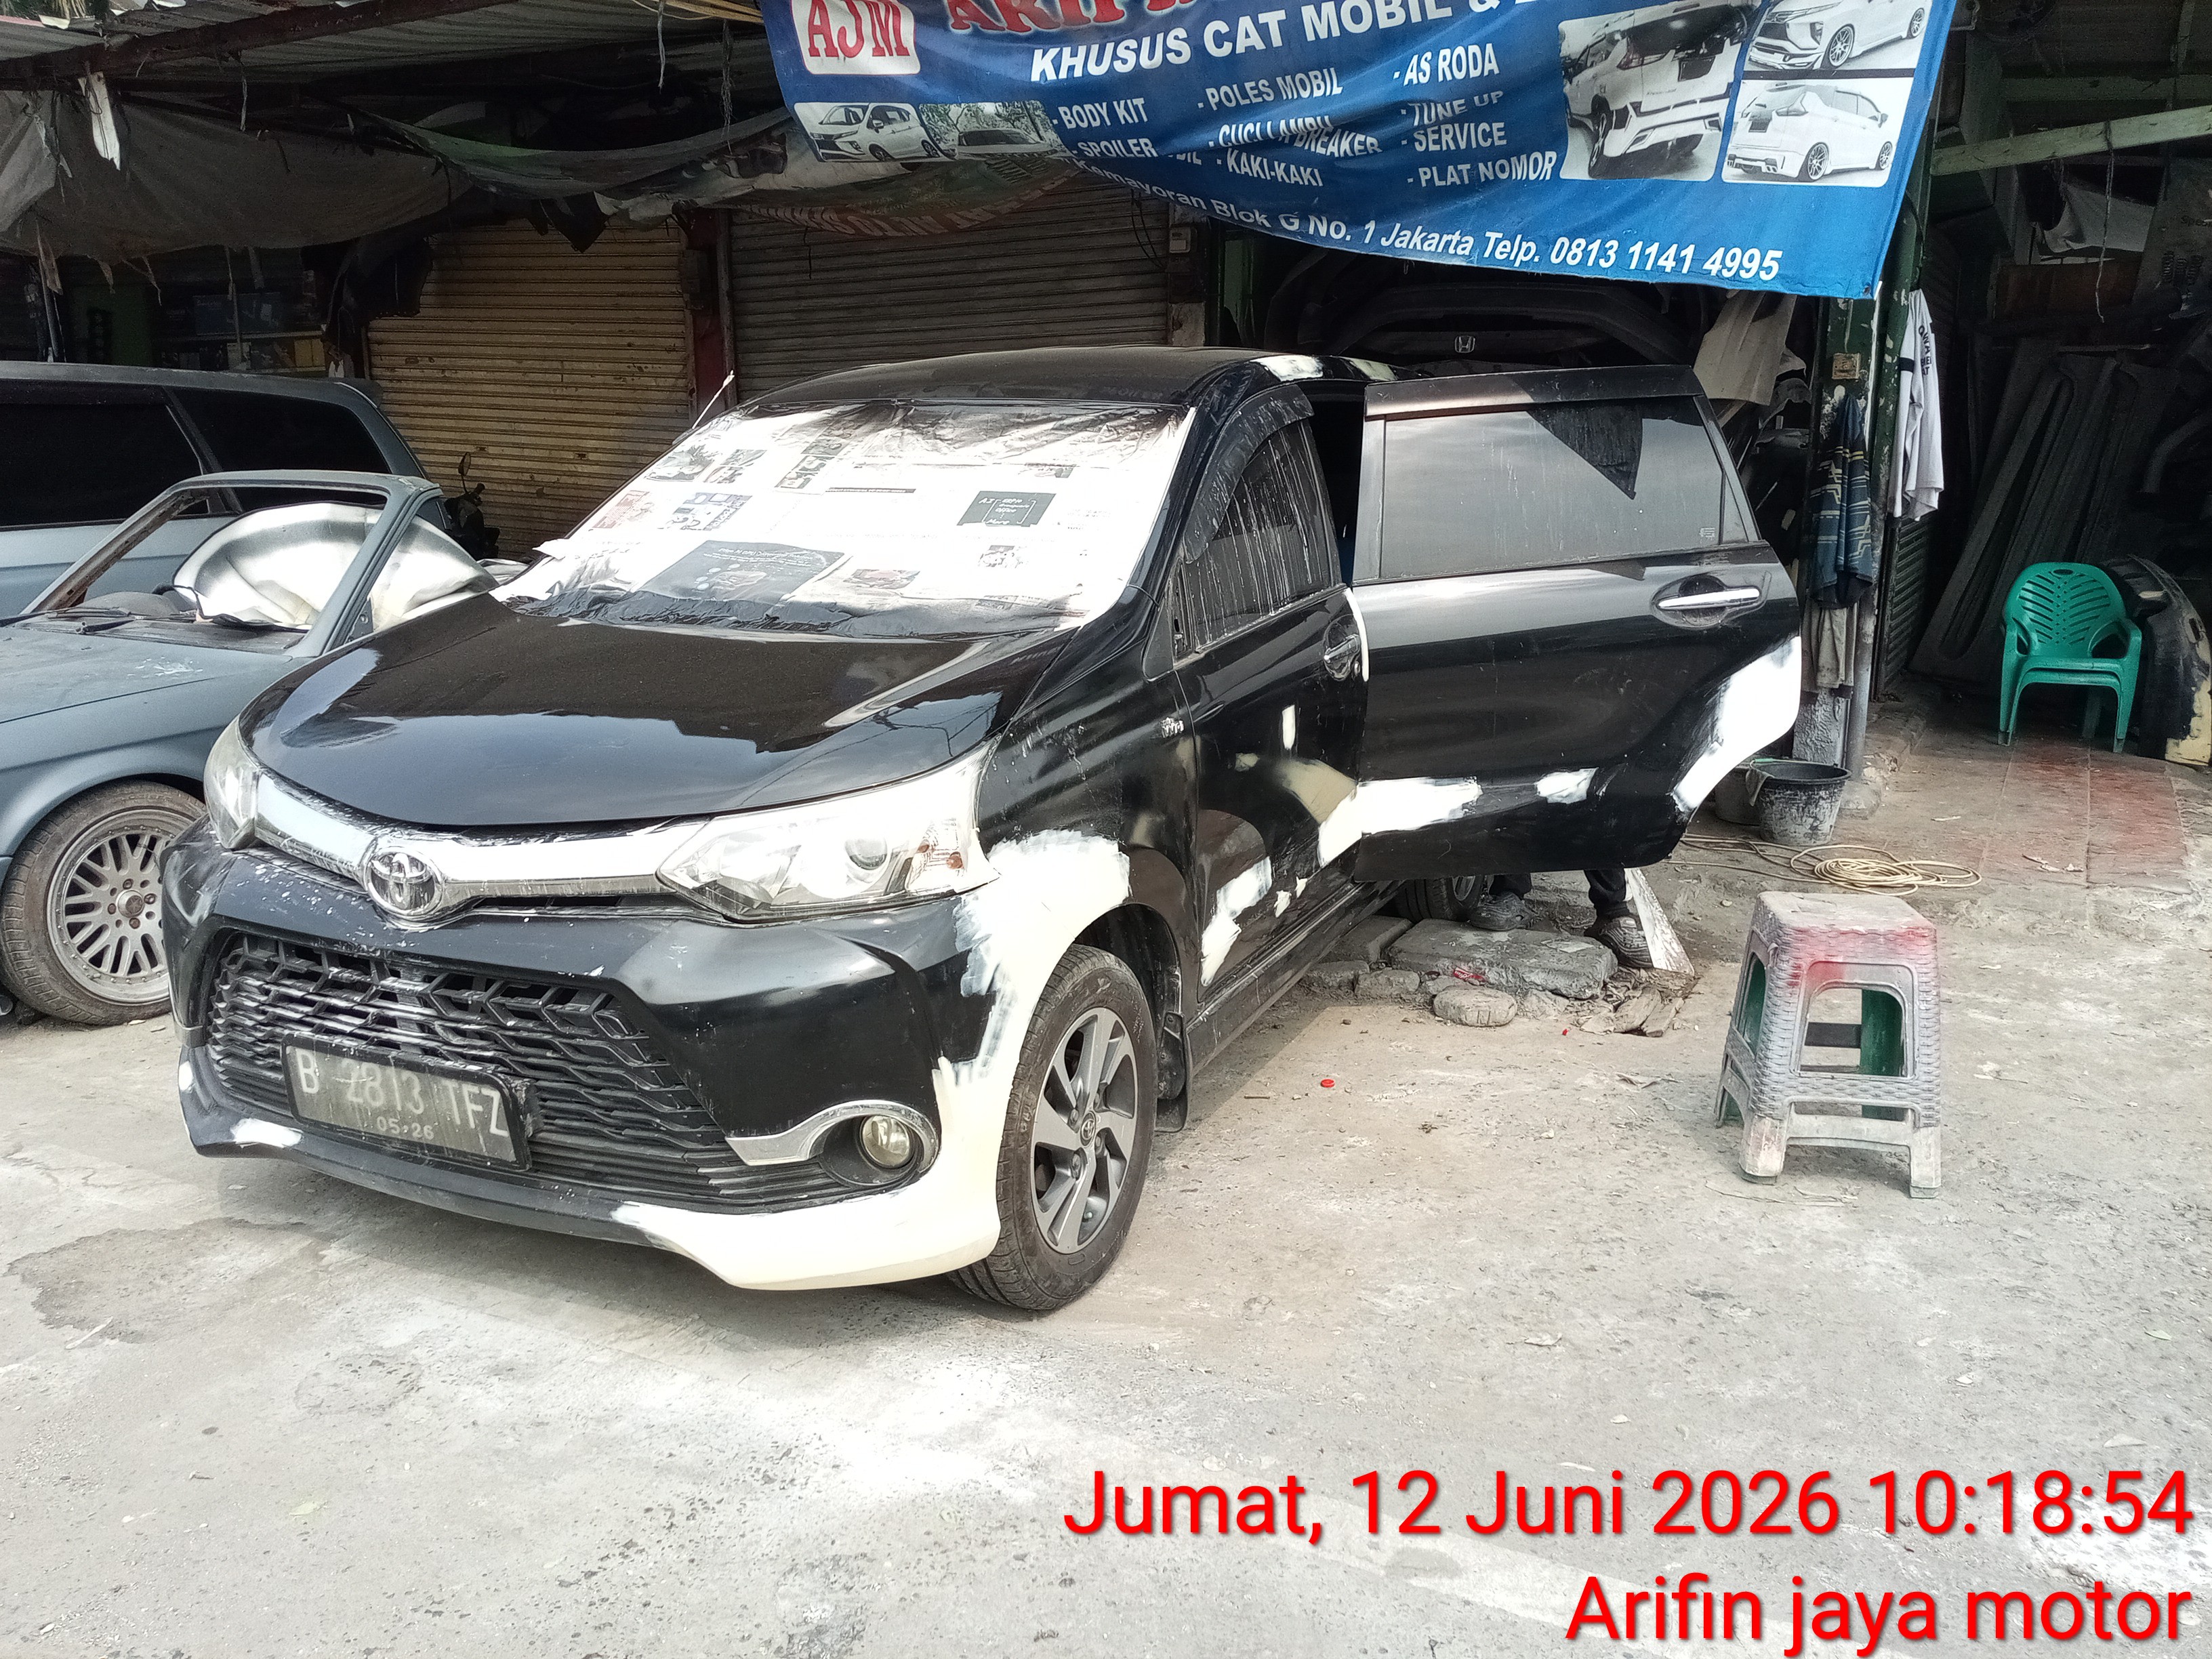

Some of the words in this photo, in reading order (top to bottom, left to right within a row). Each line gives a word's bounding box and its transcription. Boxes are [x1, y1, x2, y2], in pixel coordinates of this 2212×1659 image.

[807, 0, 911, 58] AJM
[1030, 27, 1191, 82] KHUSUS
[1202, 9, 1286, 57] CAT
[1301, 0, 1452, 41] MOBIL
[1403, 51, 1433, 86] AS
[1437, 43, 1500, 82] RODA
[1205, 79, 1275, 110] POLES
[1275, 67, 1343, 100] MOBIL
[1408, 98, 1468, 126] TUNE
[1473, 90, 1504, 106] UP
[1058, 102, 1111, 129] BODY
[1113, 98, 1148, 125] KIT
[1077, 138, 1159, 157] SPOILER
[1413, 122, 1507, 152] SERVICE
[1227, 148, 1324, 187] KAKI-KAKI
[1418, 163, 1471, 187] PLAT
[1477, 150, 1557, 183] NOMOR
[1072, 157, 1206, 210] Kemayoran
[1210, 199, 1272, 228] Blok
[1277, 213, 1300, 231] G
[1308, 215, 1351, 242] No.
[1364, 220, 1376, 244] 1
[1380, 222, 1475, 257] Jakarta
[1481, 231, 1540, 267] Telp.
[1549, 235, 1619, 269] 0813
[1626, 240, 1696, 274] 1141
[1702, 246, 1784, 281] 4995
[295, 1048, 319, 1094] B
[341, 1057, 424, 1115] 2813
